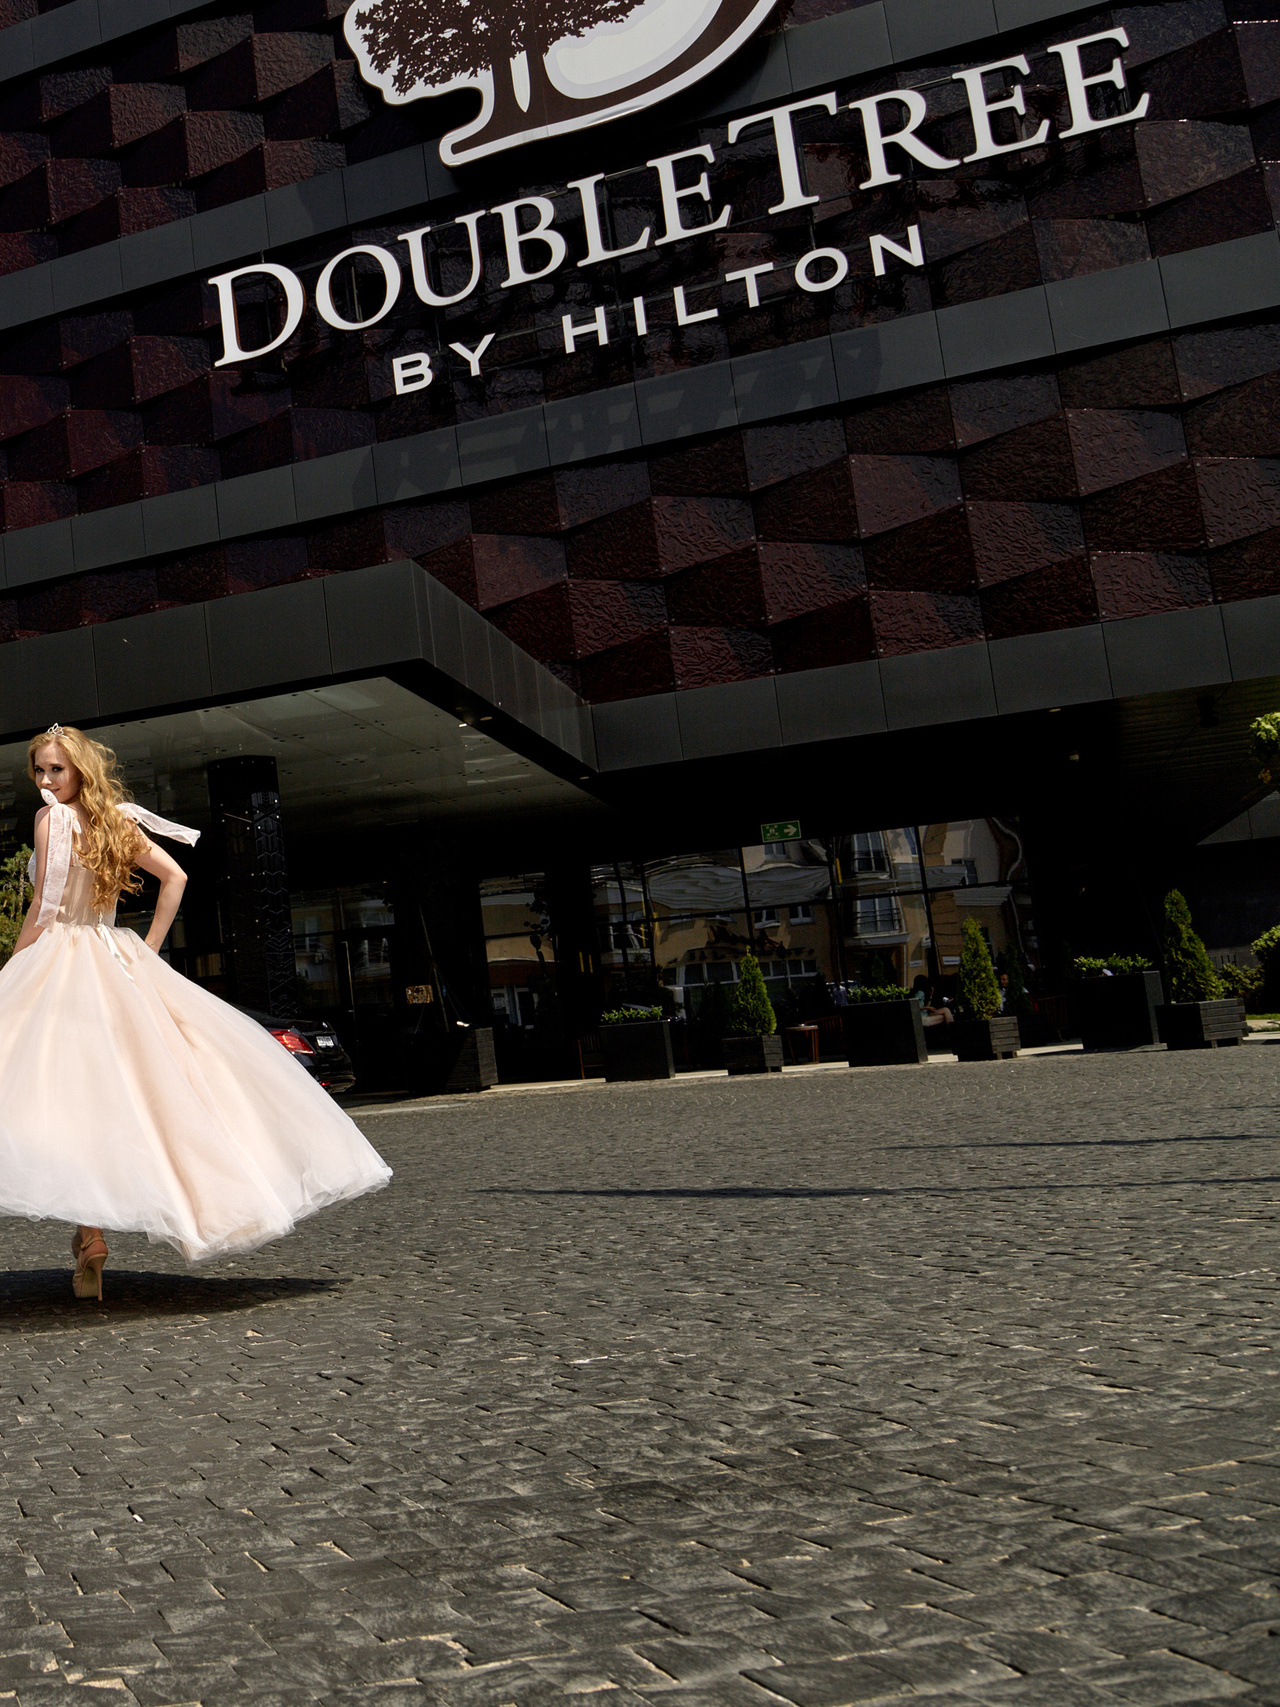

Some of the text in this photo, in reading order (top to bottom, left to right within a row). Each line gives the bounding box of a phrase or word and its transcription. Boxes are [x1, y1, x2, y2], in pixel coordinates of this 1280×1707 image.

[207, 26, 1150, 368] DOUBLETREE
[392, 224, 925, 396] BY HILTON
